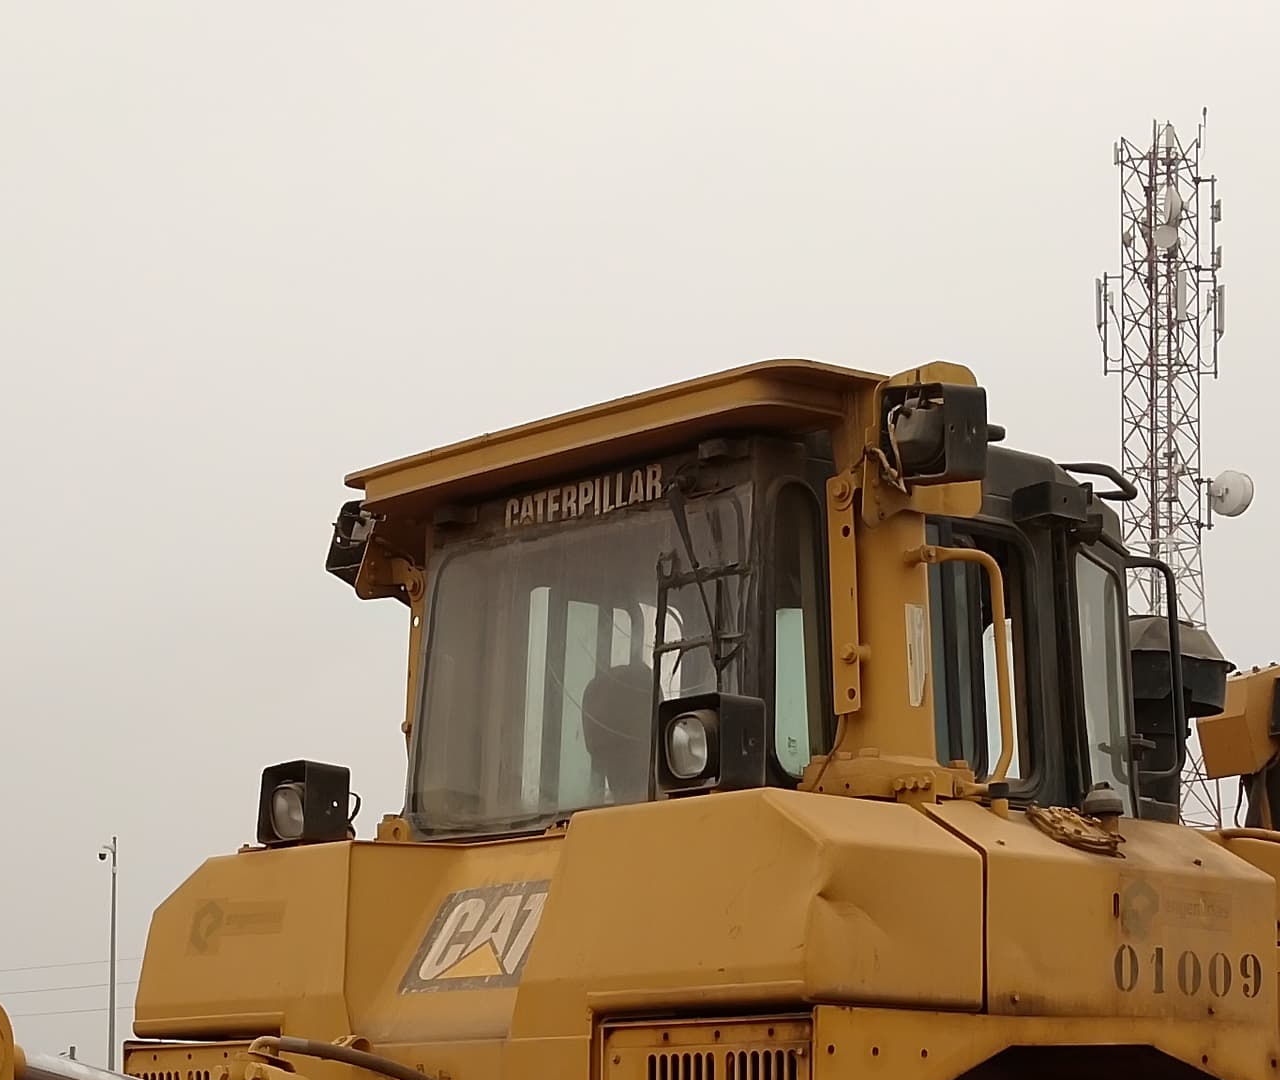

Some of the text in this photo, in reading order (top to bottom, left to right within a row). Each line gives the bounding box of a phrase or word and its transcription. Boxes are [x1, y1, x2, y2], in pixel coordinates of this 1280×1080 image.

[504, 463, 663, 529] CATERPILLAR
[418, 891, 549, 981] CAT
[1113, 943, 1262, 999] 01009
